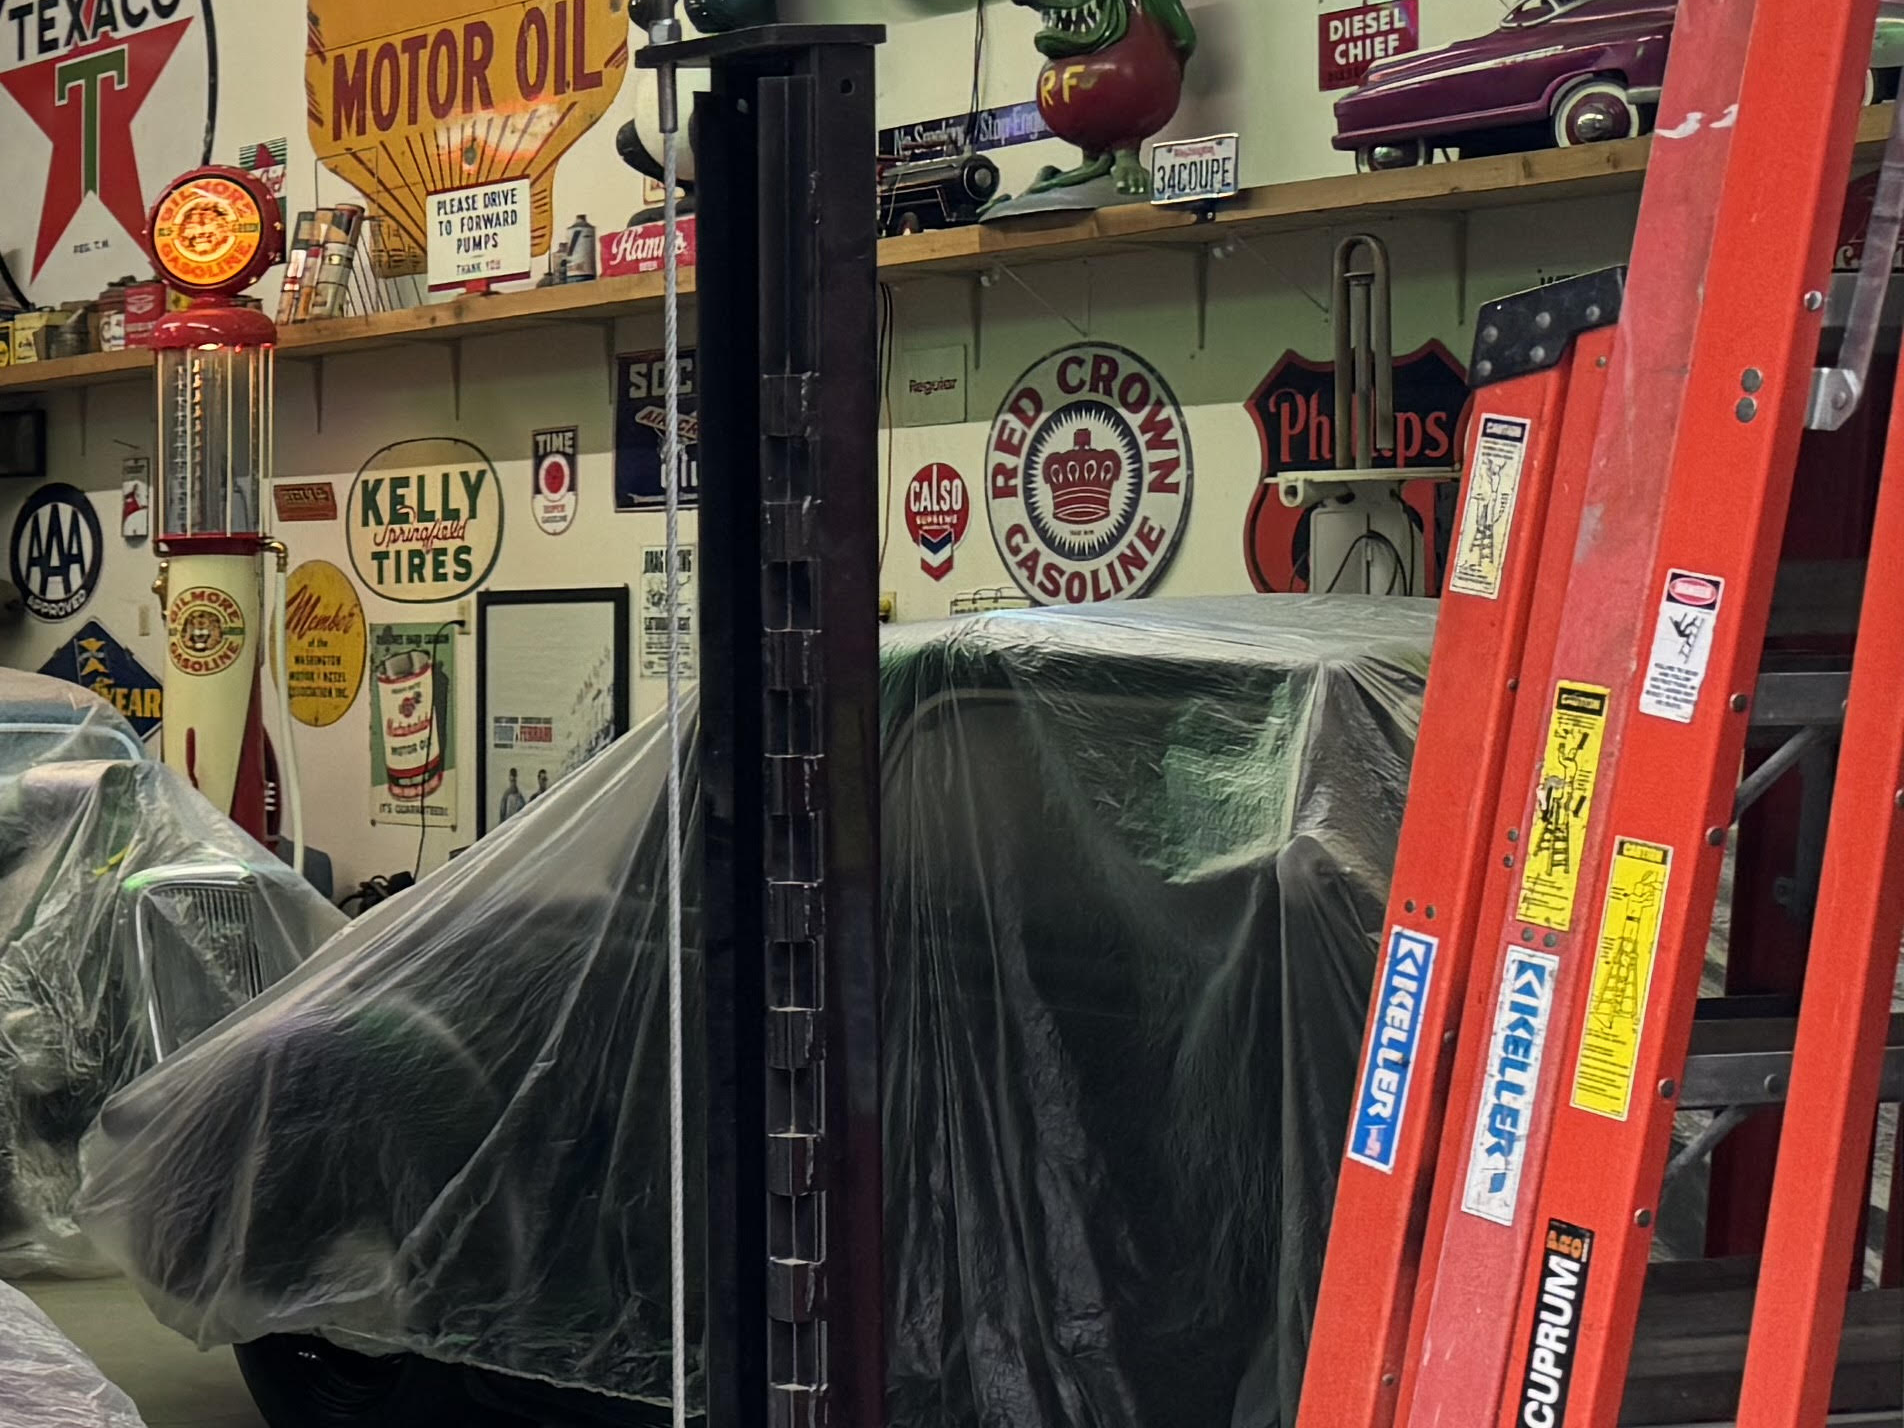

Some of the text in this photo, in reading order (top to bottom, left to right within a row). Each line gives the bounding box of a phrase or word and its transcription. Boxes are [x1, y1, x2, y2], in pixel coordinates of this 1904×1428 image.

[1329, 8, 1405, 41] DIESEL
[1334, 35, 1400, 65] CHIEF
[332, 20, 495, 141] MOTOR
[55, 46, 128, 197] T
[980, 109, 1011, 140] Stop
[1155, 155, 1233, 194] 34COUPE
[159, 181, 254, 221] GILMORE
[437, 188, 517, 216] PLEASE DRIVE
[438, 210, 517, 236] TO FORWARD
[457, 232, 498, 254] PUMPS
[161, 243, 252, 278] GASOLINE
[457, 263, 481, 275] THANK
[909, 377, 957, 395] Regular
[536, 432, 573, 454] TIME
[992, 354, 1180, 499] RED CROWN
[1269, 388, 1448, 471] Phps
[360, 470, 487, 526] KELLY
[910, 465, 962, 512] CALSO
[373, 505, 467, 548] Springfield
[25, 504, 86, 597] AAA
[371, 546, 474, 585] TIRES
[1004, 516, 1166, 605] GASOLINE
[27, 589, 86, 617] APPROVED
[170, 589, 241, 623] GILMORE
[286, 584, 357, 640] Member
[170, 641, 241, 671] GASOLINE
[308, 639, 327, 647] of the
[294, 656, 341, 665] WASHINGTON
